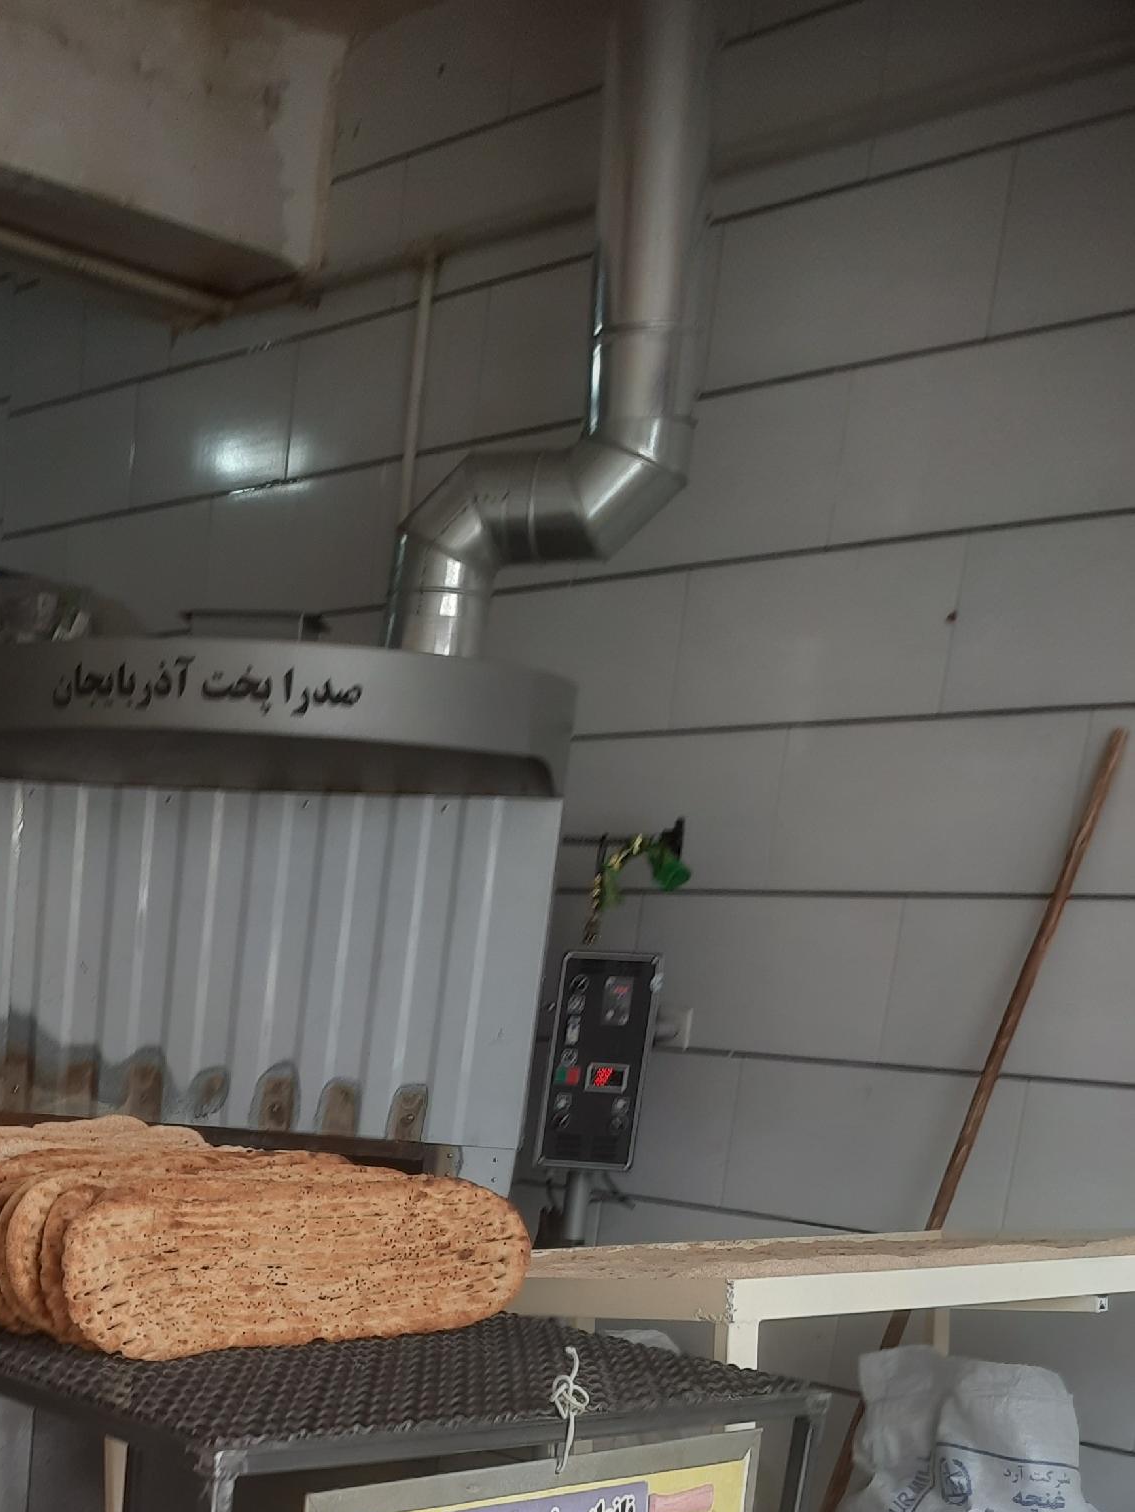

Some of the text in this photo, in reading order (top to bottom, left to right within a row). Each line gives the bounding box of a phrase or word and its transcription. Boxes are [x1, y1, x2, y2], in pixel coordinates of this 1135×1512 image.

[52, 654, 363, 718] صدرا پخت آذربایجان
[1002, 1464, 1072, 1489] شرکت آرد
